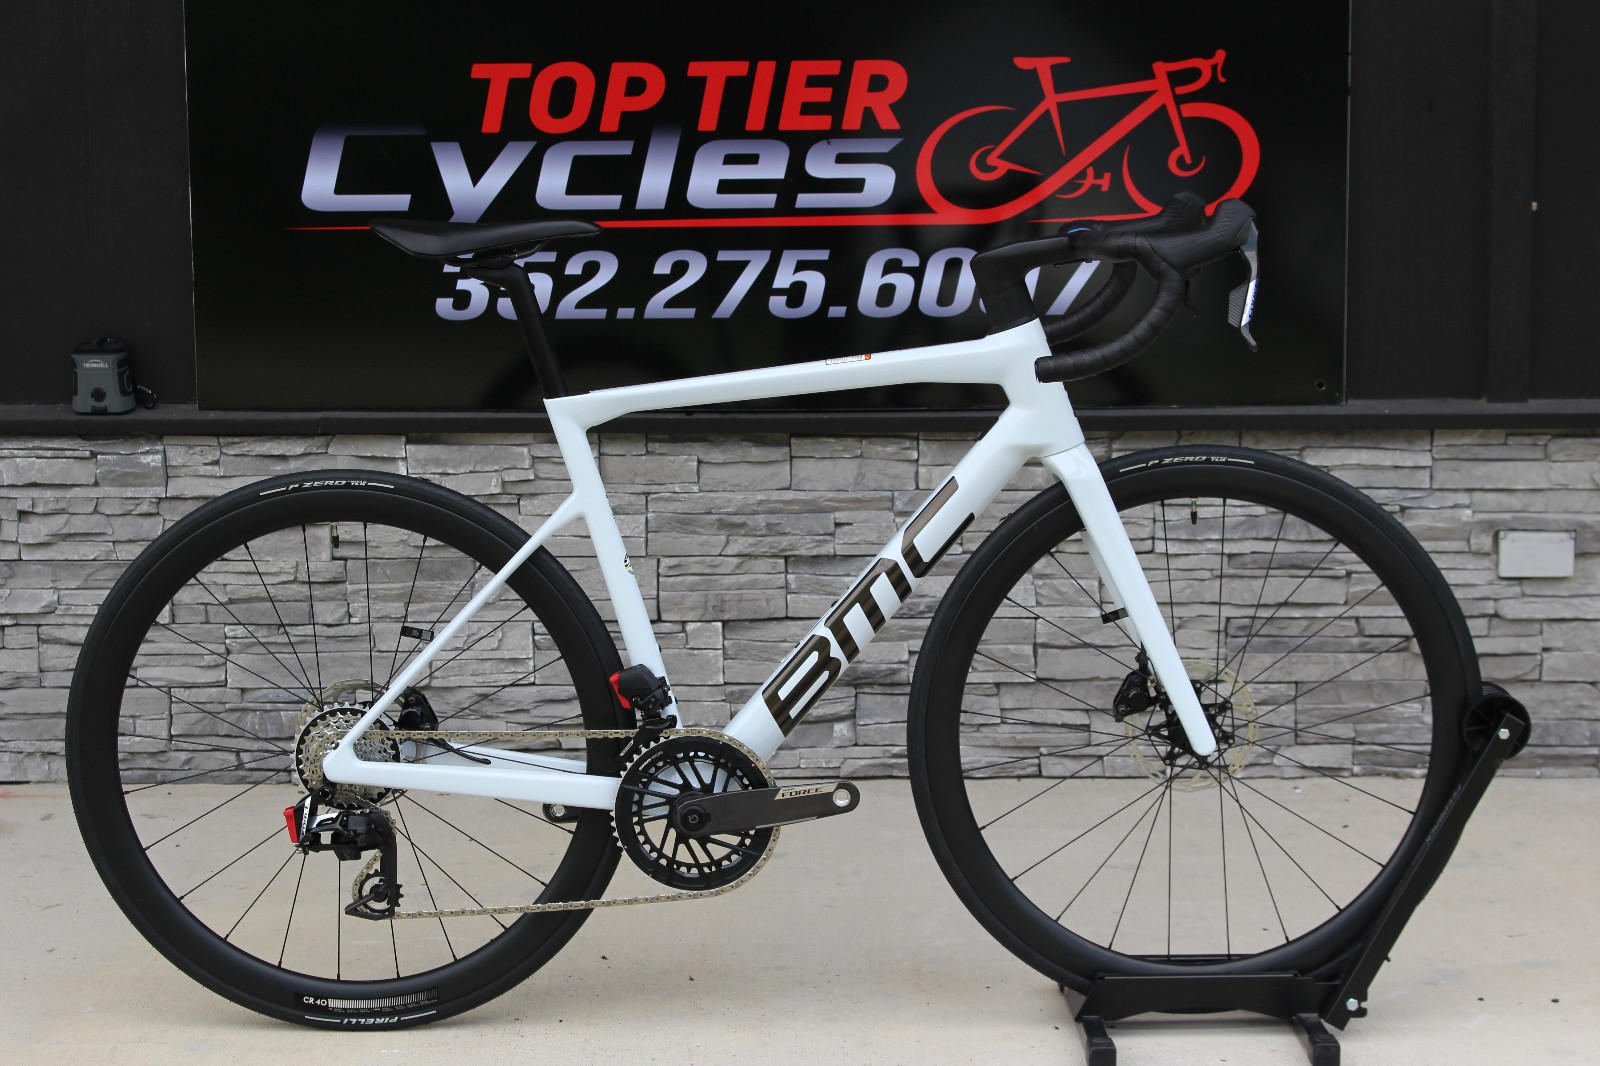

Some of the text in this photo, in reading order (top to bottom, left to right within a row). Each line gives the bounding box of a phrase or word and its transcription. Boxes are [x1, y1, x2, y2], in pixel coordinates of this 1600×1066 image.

[470, 59, 908, 134] TOP TIER
[301, 123, 904, 223] Cycles
[435, 247, 1101, 321] 352.275.607
[1161, 456, 1207, 464] ZERO
[302, 480, 346, 488] ZERO
[781, 787, 823, 797] FORCE
[342, 1016, 398, 1025] PIRELLI
